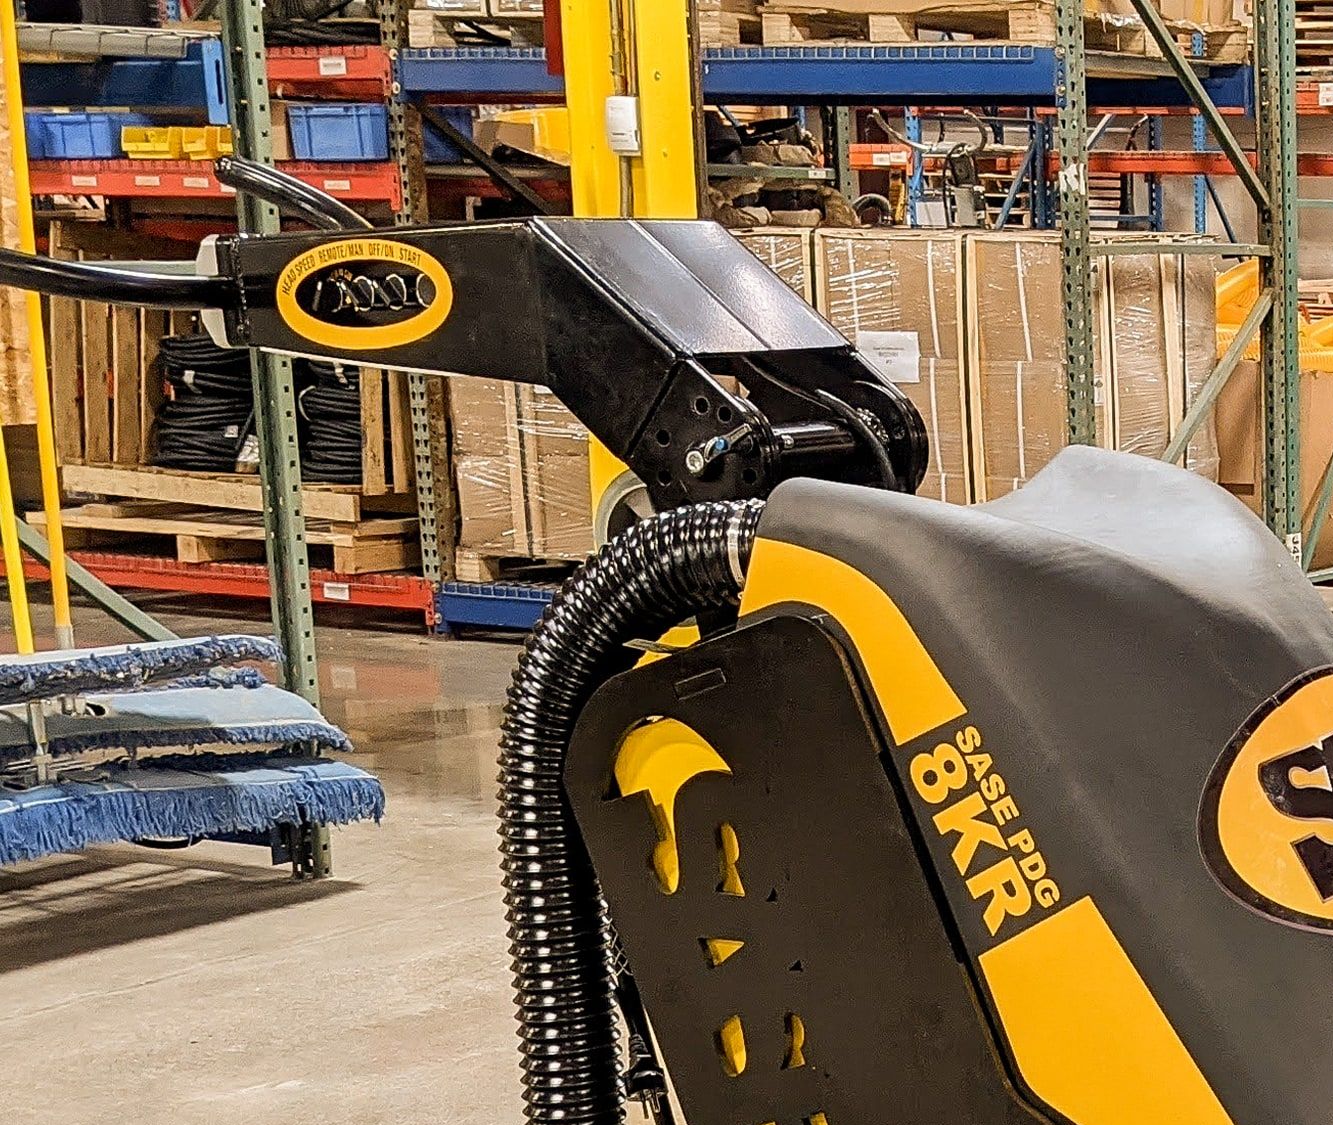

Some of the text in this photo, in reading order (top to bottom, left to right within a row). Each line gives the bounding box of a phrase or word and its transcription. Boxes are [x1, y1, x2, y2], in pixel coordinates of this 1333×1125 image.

[282, 242, 421, 295] HEAD SPEED REMOTE/MAN OFF/ON START
[909, 742, 1032, 937] 8KR
[955, 725, 1061, 909] SASE PDG
